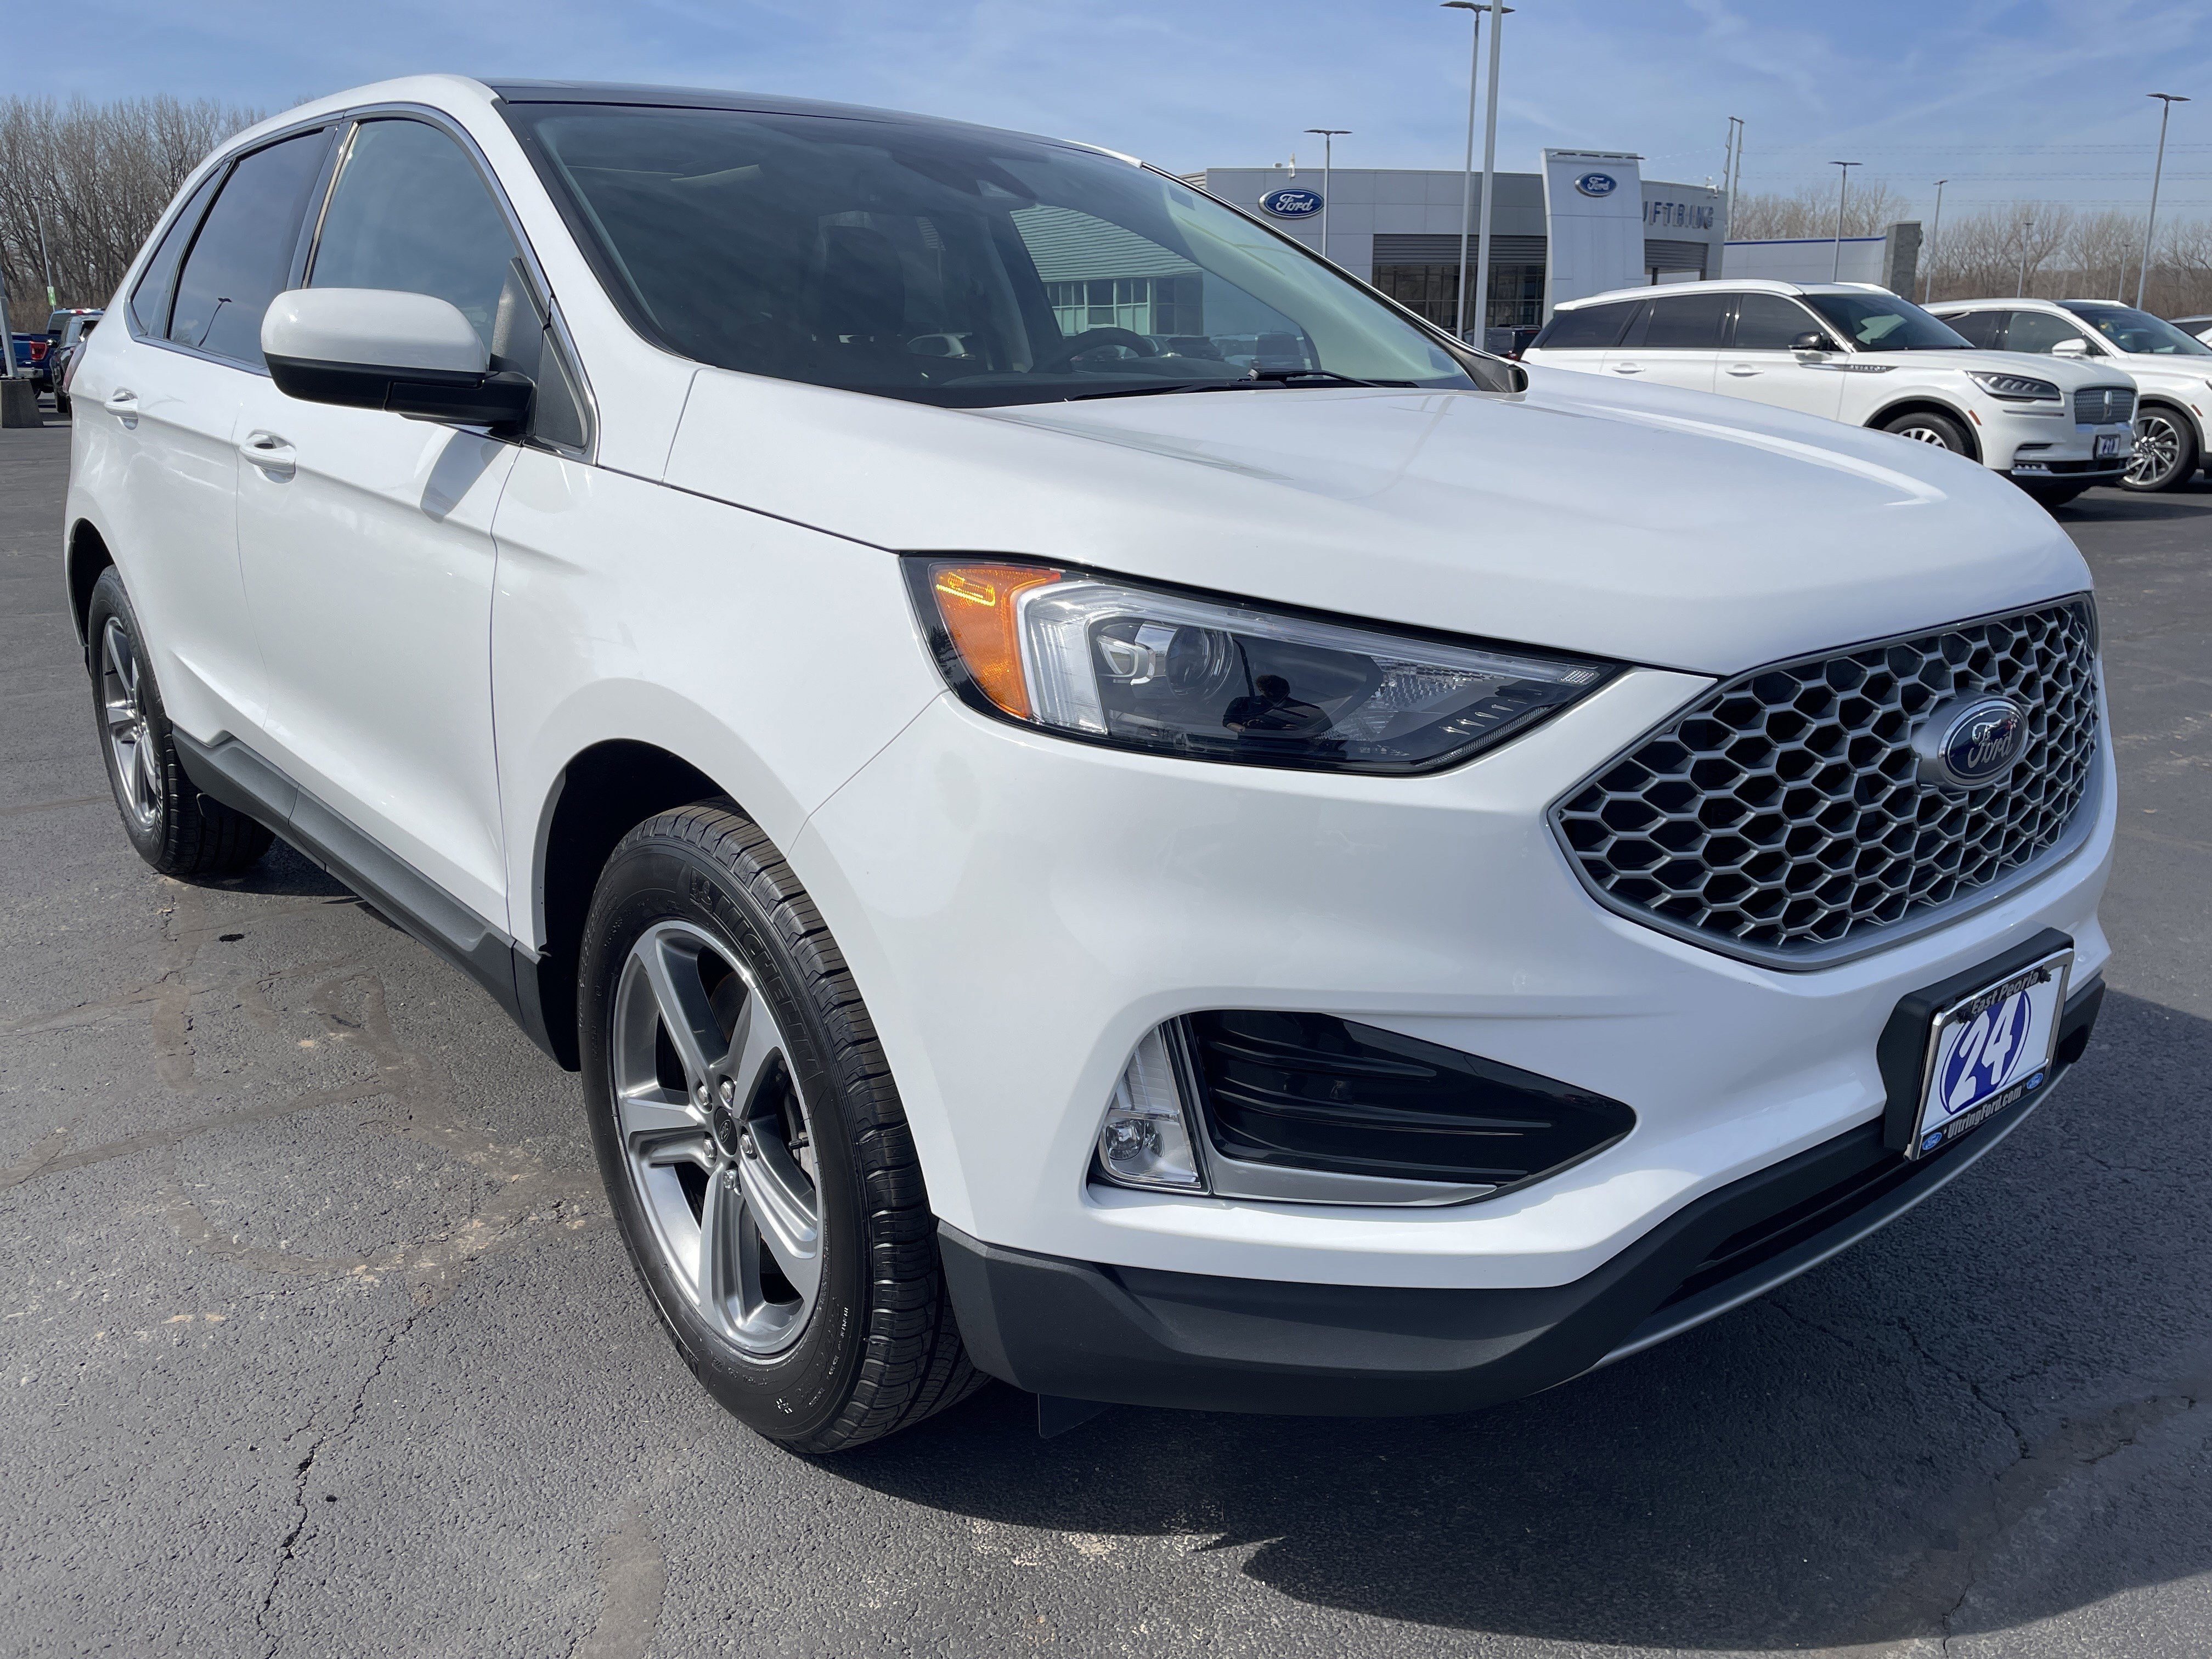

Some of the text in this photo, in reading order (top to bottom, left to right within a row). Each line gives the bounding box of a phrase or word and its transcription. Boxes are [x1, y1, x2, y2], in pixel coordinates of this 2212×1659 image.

[1276, 193, 1314, 211] Ford
[1587, 176, 1610, 190] Ford
[1967, 718, 2013, 769] Ford
[713, 894, 821, 1073] MICHELIN
[1971, 970, 2039, 1015] East Peoria
[1948, 991, 2022, 1113] 24
